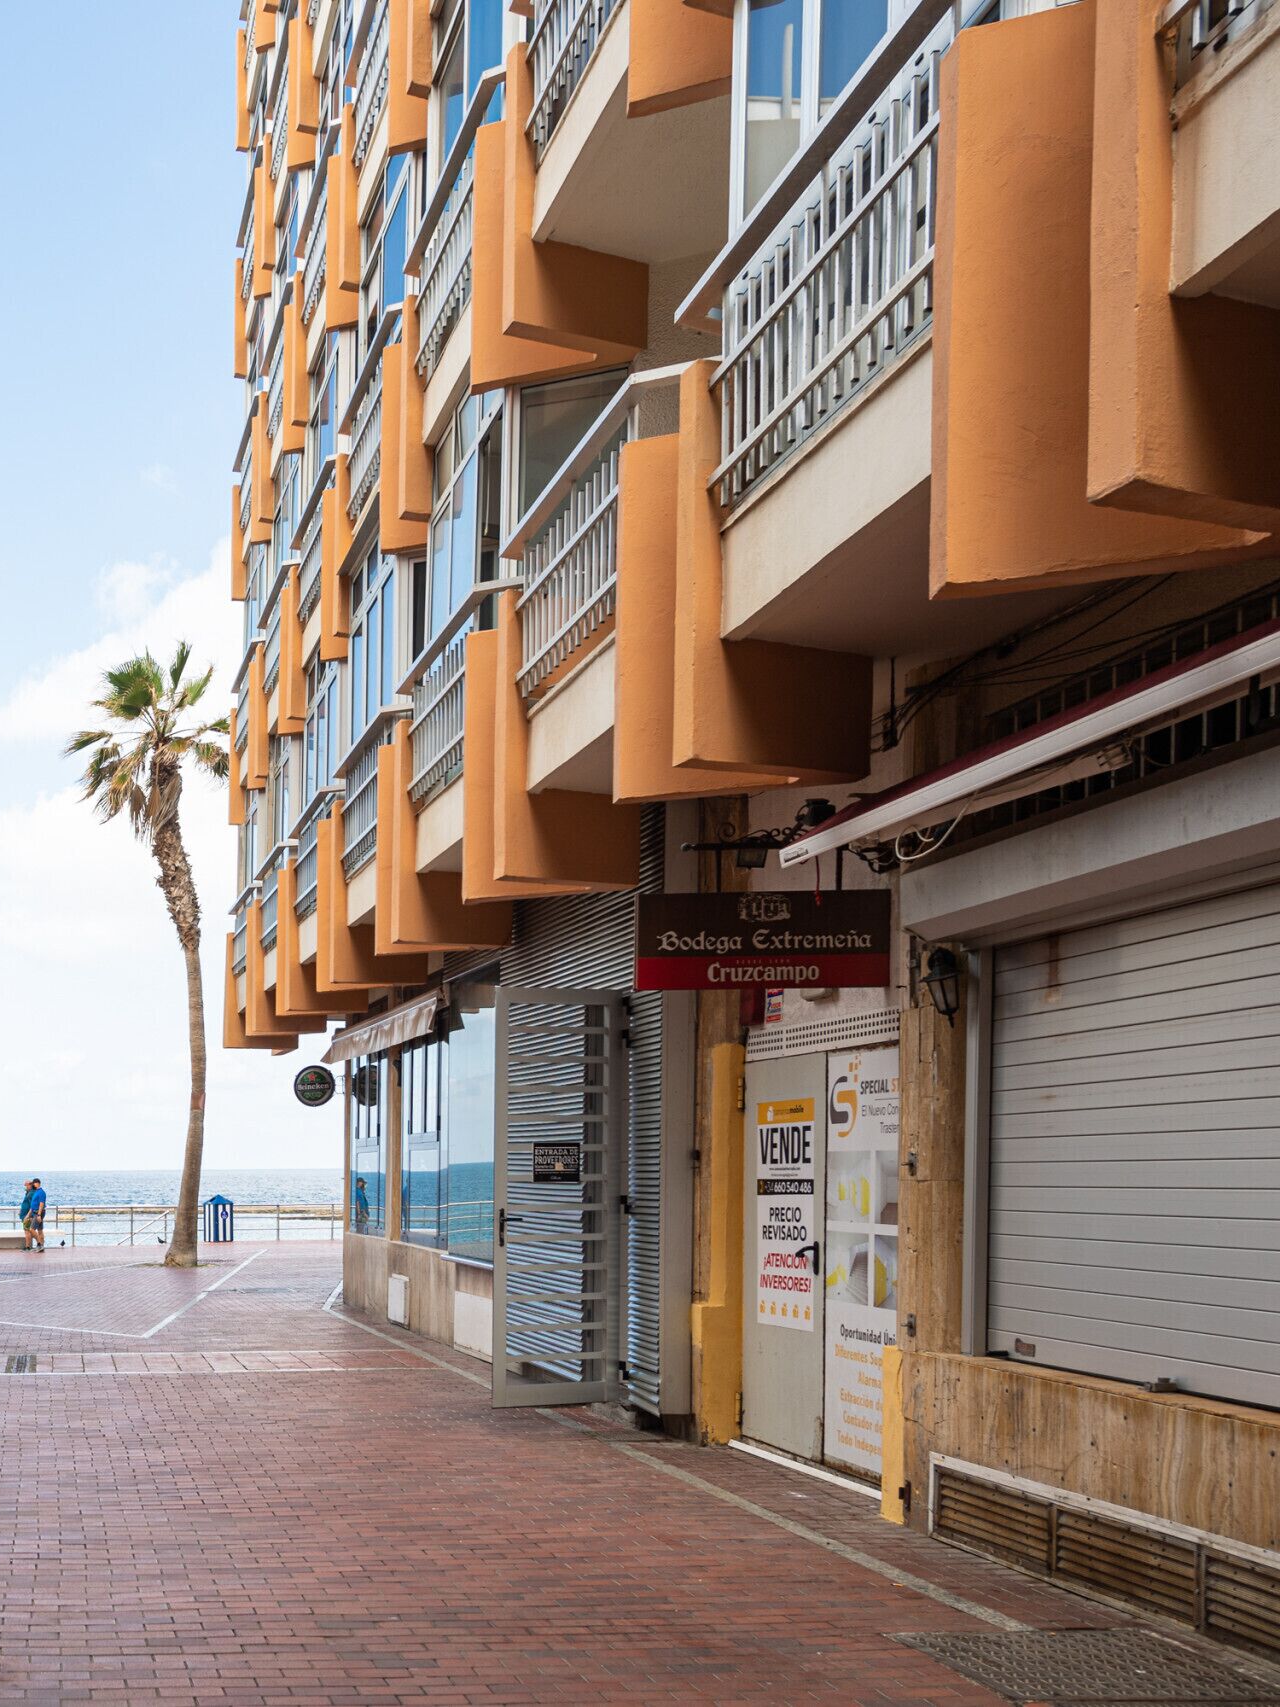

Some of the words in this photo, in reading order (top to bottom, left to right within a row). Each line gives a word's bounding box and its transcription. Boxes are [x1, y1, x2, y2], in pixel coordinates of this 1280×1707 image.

[656, 930, 742, 954] Bodega
[752, 929, 872, 949] Extremeña
[707, 961, 820, 983] Cruzcampo
[860, 1078, 889, 1095] SPECIAL
[868, 1104, 886, 1117] Nuevo
[535, 1148, 568, 1156] ENTRADA
[569, 1148, 579, 1156] DE
[759, 1125, 812, 1165] VENDE
[534, 1155, 579, 1165] PROVEEDORES
[774, 1181, 786, 1193] 660
[786, 1181, 799, 1193] 540
[799, 1181, 812, 1193] 486
[769, 1207, 802, 1223] PRECIO
[762, 1225, 807, 1241] REVISADO
[760, 1273, 812, 1293] INVERSORES!
[840, 1323, 882, 1345] Oportunidad
